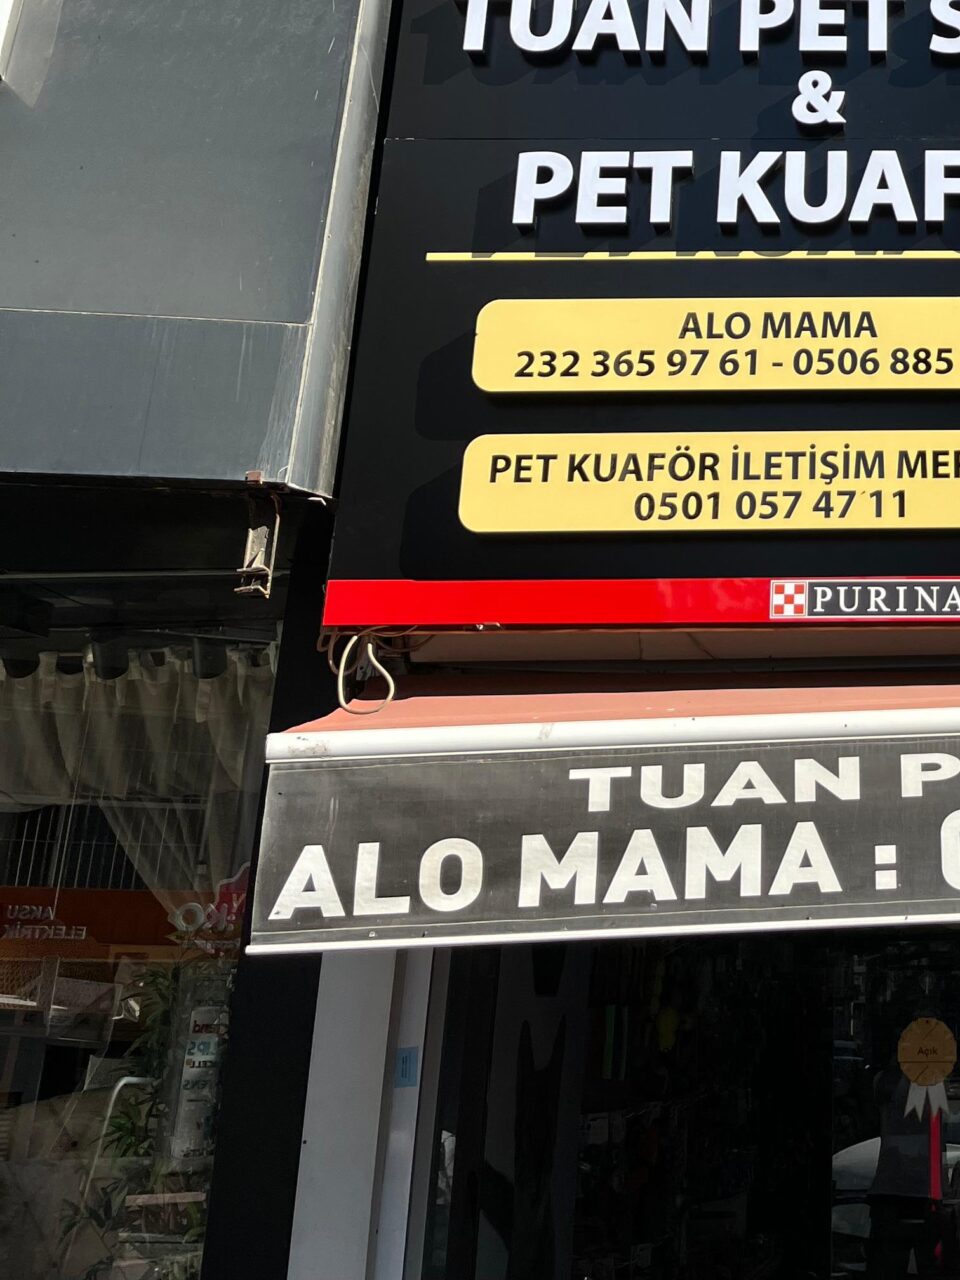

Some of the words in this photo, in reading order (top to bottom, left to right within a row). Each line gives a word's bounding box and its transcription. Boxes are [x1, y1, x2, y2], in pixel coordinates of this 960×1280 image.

[791, 70, 847, 125] &
[512, 150, 694, 226] PET
[678, 311, 752, 340] ALO
[761, 311, 879, 339] MAMA
[514, 350, 581, 378] 232
[590, 349, 656, 377] 365
[667, 348, 710, 376] 97
[718, 348, 759, 376] 61
[792, 347, 881, 376] 0506
[889, 347, 955, 375] 885
[489, 454, 558, 483] PET
[567, 445, 721, 483] KUAFÖR
[730, 443, 886, 486] İLETİŞİM
[633, 491, 721, 521] 0501
[735, 491, 803, 520] 057
[812, 490, 857, 519] 47
[869, 490, 907, 518] 11
[568, 756, 861, 813] TUAN
[268, 837, 484, 920] ALO
[519, 821, 842, 908] MAMA
[875, 844, 897, 890] :
[917, 1047, 939, 1057] Açık
